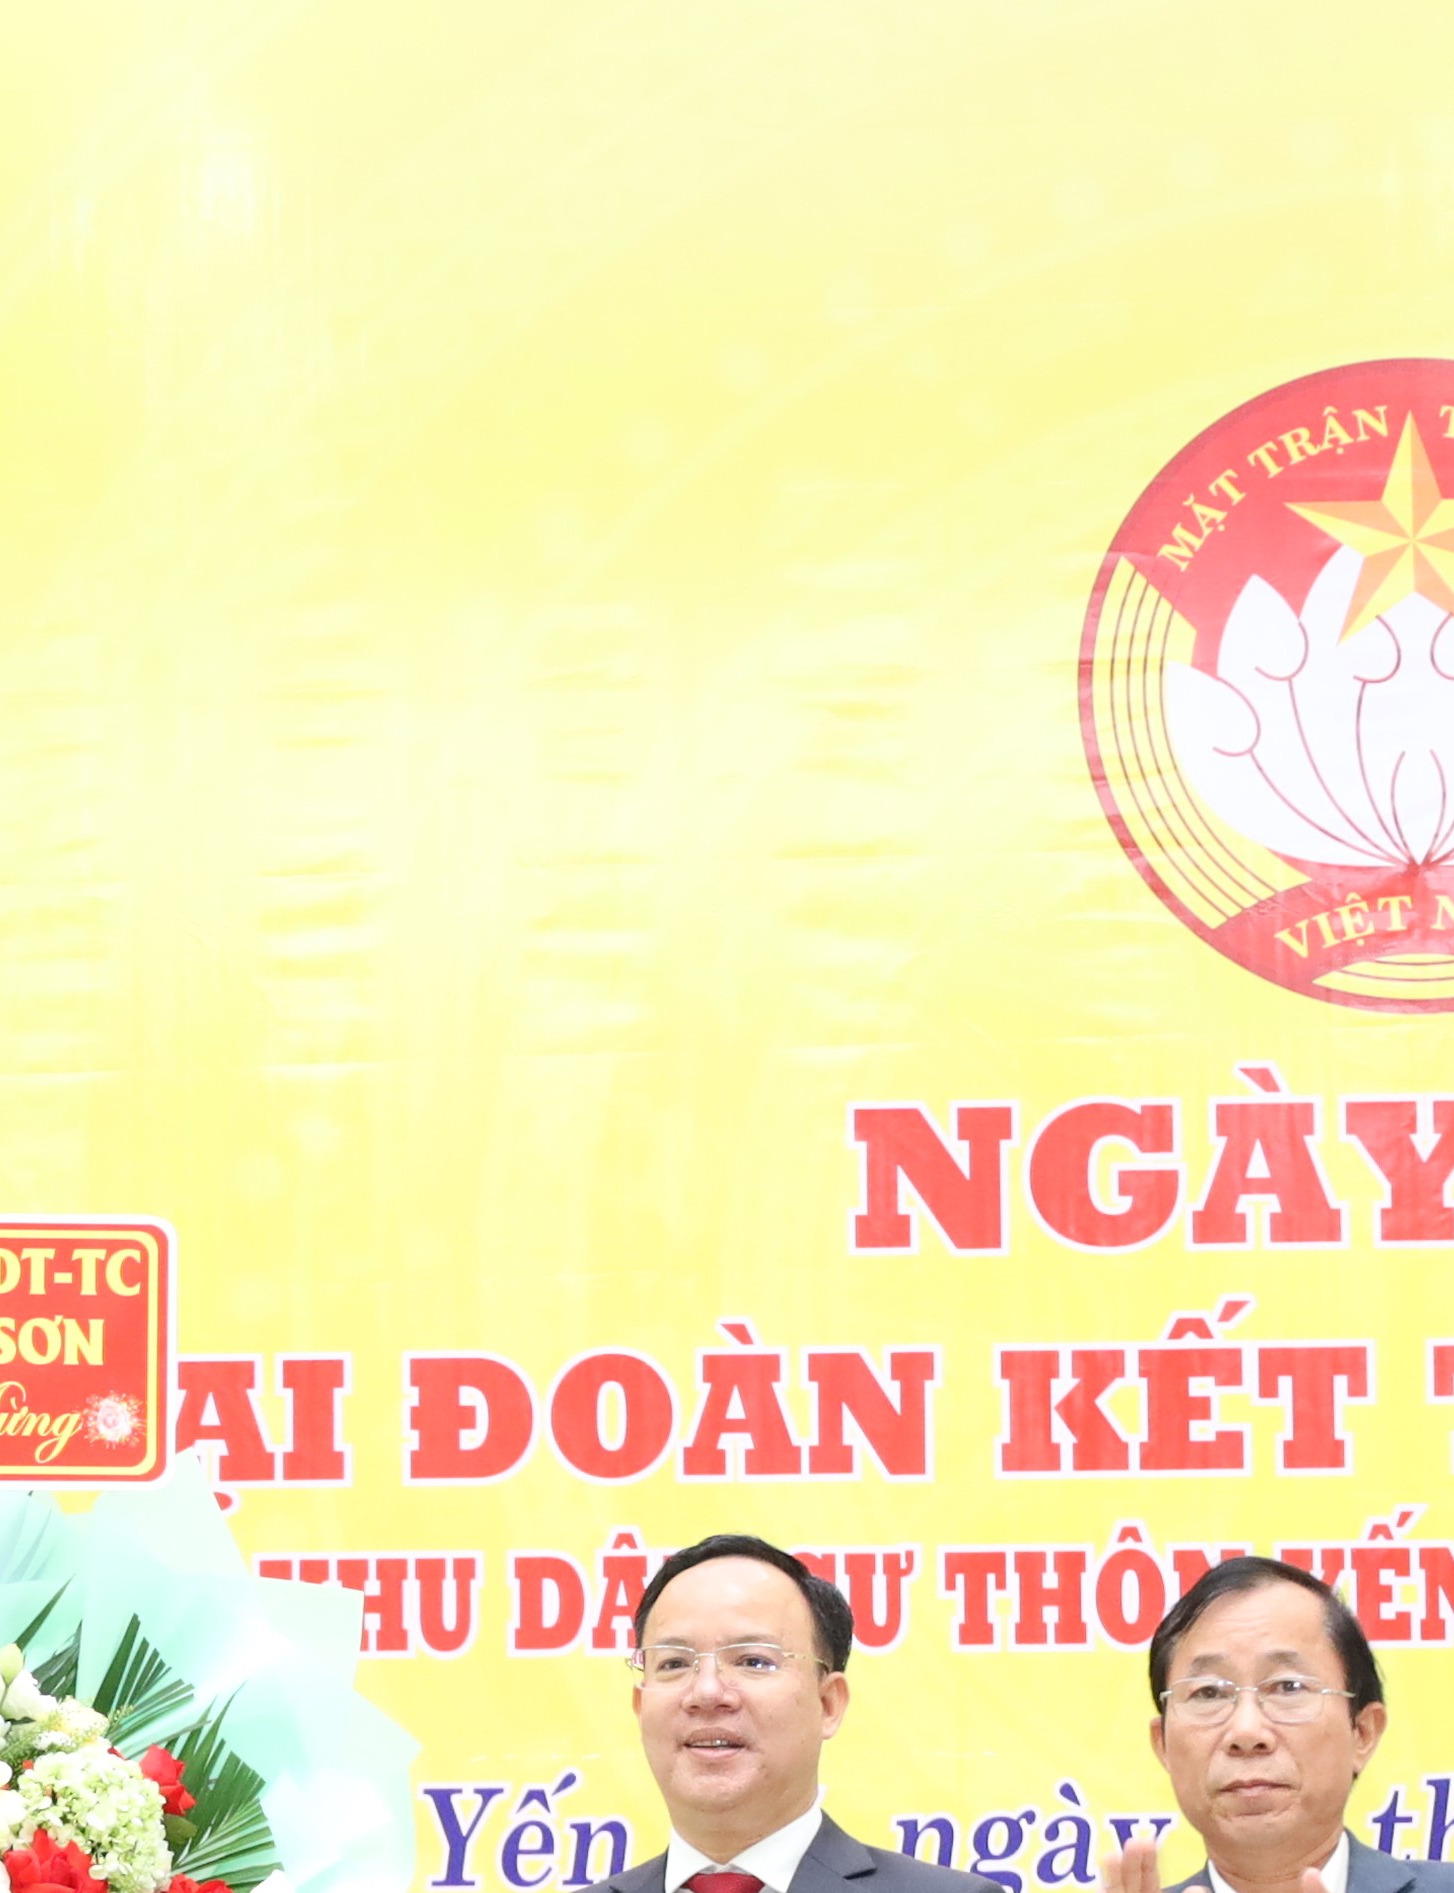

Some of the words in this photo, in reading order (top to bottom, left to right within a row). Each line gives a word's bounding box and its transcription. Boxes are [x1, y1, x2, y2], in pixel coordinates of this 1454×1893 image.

[1156, 468, 1247, 573] MẶT
[1247, 405, 1390, 480] TRẬN
[1274, 891, 1413, 959] VIỆT
[176, 1359, 345, 1512] ẠI
[409, 1323, 935, 1479] ĐOÀN
[1000, 1300, 1368, 1473] KẾT
[260, 1557, 477, 1653] HU
[514, 1533, 676, 1650] DÂ
[422, 1772, 628, 1889] Yến
